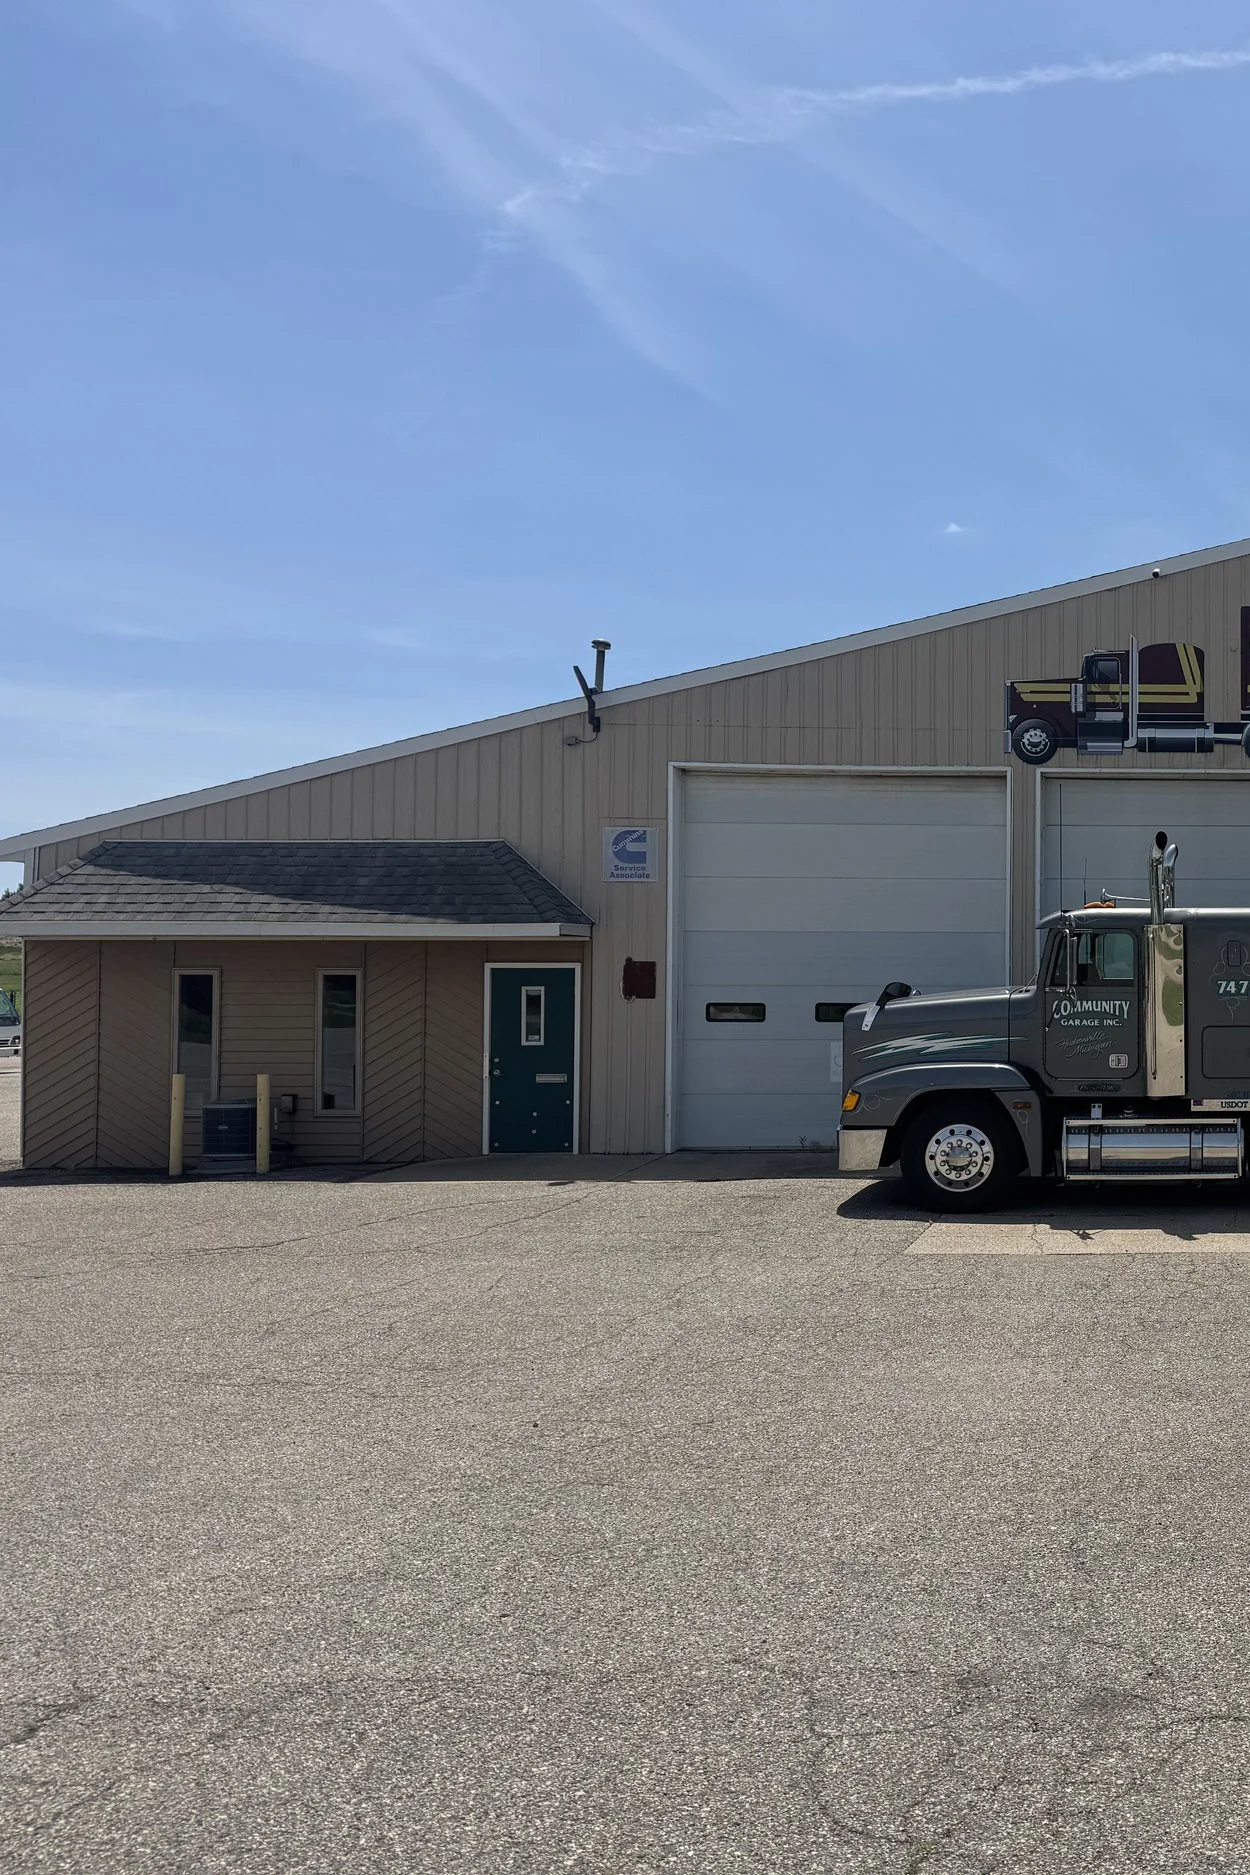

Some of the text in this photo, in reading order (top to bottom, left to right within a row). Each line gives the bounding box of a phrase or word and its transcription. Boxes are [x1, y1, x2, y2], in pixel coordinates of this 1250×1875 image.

[614, 864, 647, 872] Service
[1217, 981, 1250, 994] 747
[1052, 1000, 1130, 1019] COMMUNITY
[1220, 1101, 1248, 1109] USDOT
